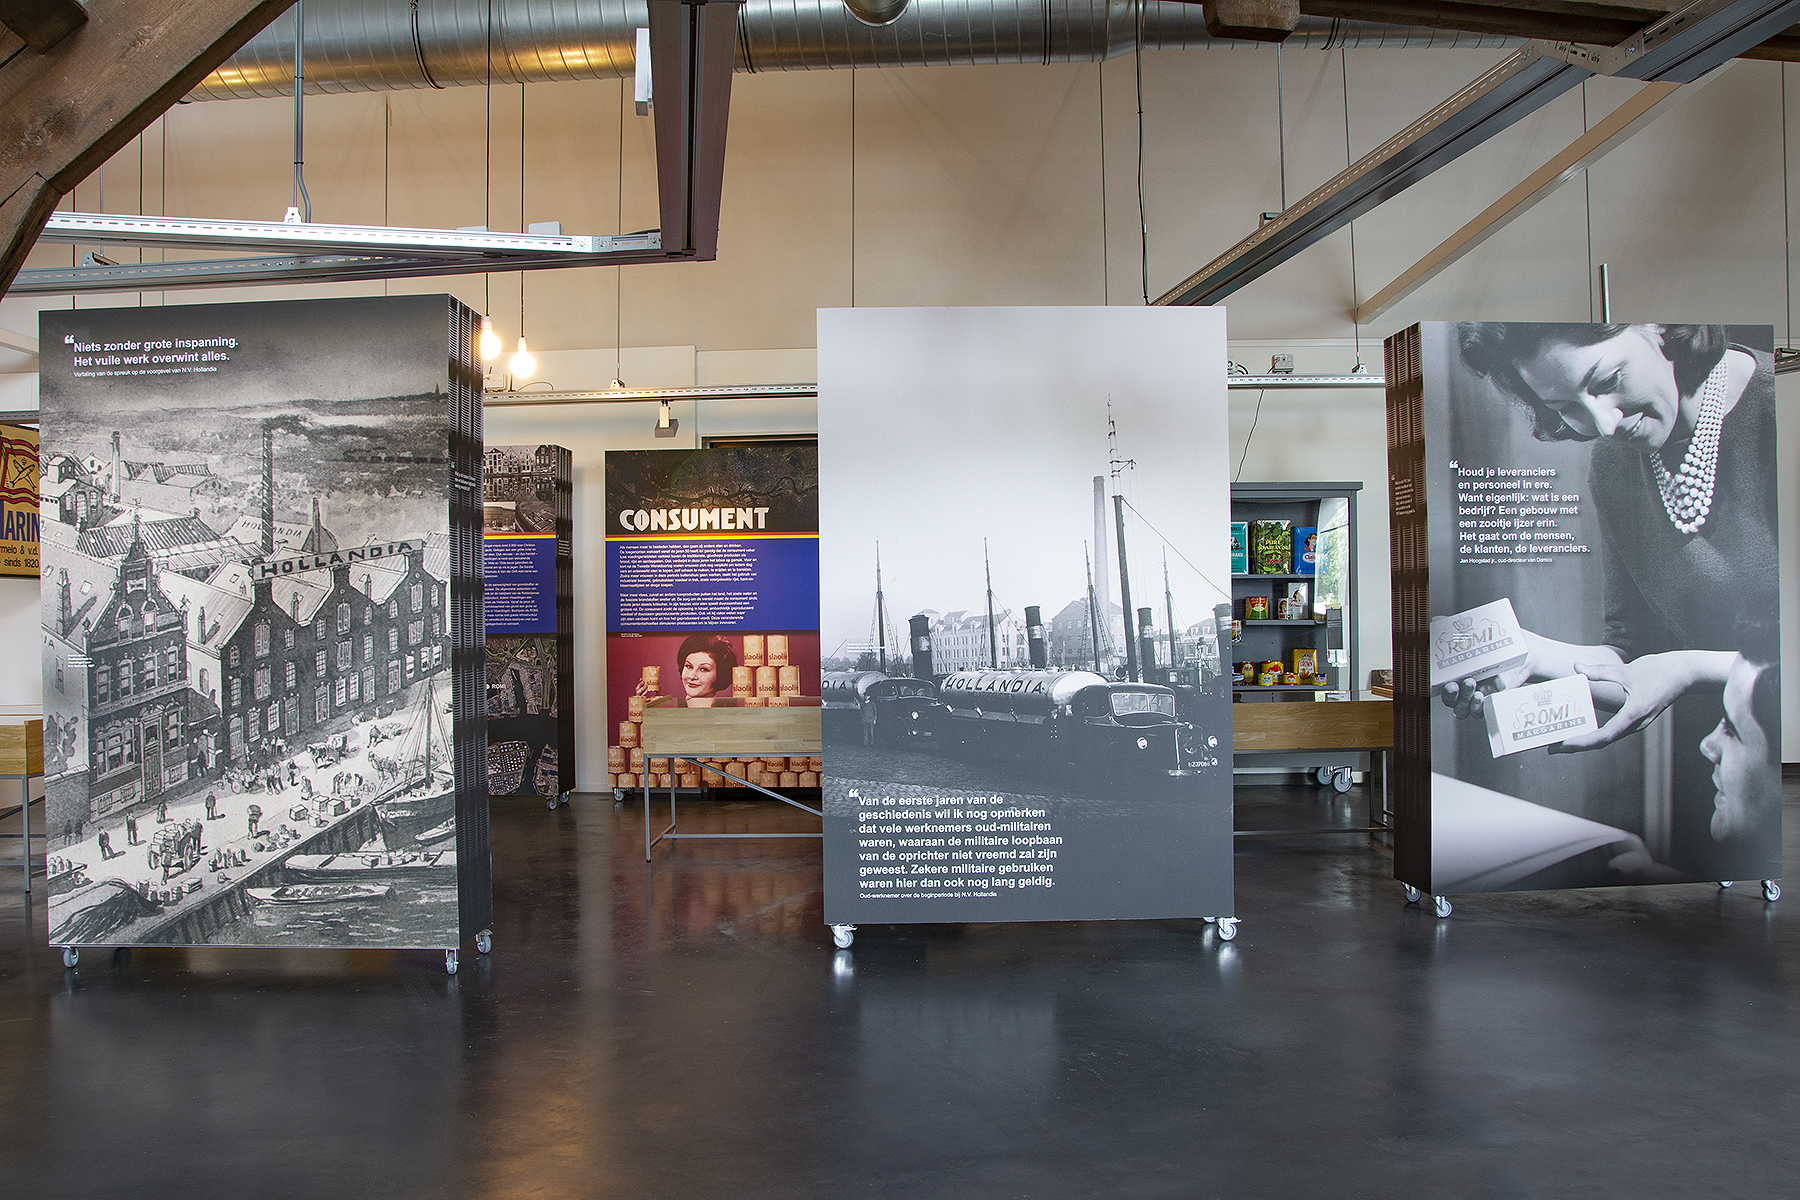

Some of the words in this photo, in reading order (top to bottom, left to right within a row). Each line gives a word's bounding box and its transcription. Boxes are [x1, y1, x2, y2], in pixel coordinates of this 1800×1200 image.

[73, 342, 102, 352] Niets
[103, 340, 142, 351] zonder
[143, 339, 172, 352] grote
[175, 336, 239, 349] inspanning.
[74, 356, 93, 367] Het
[94, 355, 121, 366] vuile
[123, 353, 150, 364] werk
[151, 352, 199, 363] overwint
[201, 350, 231, 362] alles.
[1457, 467, 1484, 477] Houd
[1485, 467, 1496, 478] je
[1497, 466, 1556, 477] leveranciers
[1457, 481, 1471, 489] en
[1472, 479, 1521, 491] personeel
[1522, 479, 1532, 489] in
[1533, 481, 1553, 489] ere.
[1458, 492, 1484, 502] Want
[1485, 492, 1529, 504] eigenlijk:
[1530, 492, 1549, 502] wat
[1550, 492, 1560, 502] is
[1561, 494, 1580, 502] een
[1458, 505, 1496, 517] bedrijf?
[1498, 505, 1517, 515] Een
[1519, 505, 1558, 517] gebouw
[1559, 505, 1578, 515] met
[0, 500, 40, 542] ARIN
[619, 507, 770, 532] CONSUMENT
[1458, 520, 1477, 528] een
[1478, 518, 1512, 529] zooitje
[1513, 518, 1535, 530] ijzer
[1536, 517, 1559, 528] erin.
[1459, 531, 1477, 541] Het
[1478, 531, 1500, 543] gaat
[1501, 532, 1518, 541] om
[1519, 530, 1532, 540] de
[1534, 532, 1575, 542] mensen,
[1459, 544, 1472, 554] de
[1474, 544, 1513, 556] klanten,
[1514, 543, 1528, 553] de
[1529, 543, 1591, 553] leveranciers.
[4, 557, 22, 567] sinds
[24, 558, 40, 568] 1820
[261, 542, 413, 578] HOLLANDIA
[1441, 639, 1511, 668] MARGARINE
[944, 677, 1043, 694] HOLLANDIA
[1524, 703, 1569, 729] ROMI
[1516, 718, 1584, 740] MARGARINE
[858, 795, 880, 806] Van
[881, 794, 896, 806] de
[898, 794, 934, 806] eerste
[933, 794, 964, 807] jaren
[966, 794, 987, 805] van
[989, 794, 1004, 804] de
[858, 809, 932, 822] geschiedenis
[934, 808, 951, 819] wil
[953, 808, 964, 819] ik
[966, 810, 988, 821] nog
[990, 806, 1046, 820] opmerken
[858, 823, 877, 834] dat
[878, 823, 902, 833] vele
[904, 823, 972, 833] werknemers
[975, 821, 1051, 832] oud-militairen
[858, 839, 896, 849] waren,
[898, 838, 945, 847] waaraan
[947, 836, 962, 846] de
[964, 835, 1009, 846] militaire
[1011, 835, 1063, 847] loopbaan
[858, 852, 880, 861] van
[881, 850, 896, 861] de
[898, 850, 949, 862] oprichter
[951, 849, 973, 860] niet
[975, 848, 1017, 859] vreemd
[1018, 848, 1035, 859] zal
[1037, 848, 1057, 861] zijn
[859, 864, 909, 877] geweest.
[910, 864, 949, 874] Zekere
[951, 863, 996, 874] militaire
[998, 862, 1054, 875] gebruiken
[859, 880, 893, 888] waren
[895, 877, 918, 888] hier
[919, 877, 941, 888] dan
[943, 877, 965, 887] ook
[967, 878, 989, 889] nog
[991, 876, 1016, 889] lang
[1018, 875, 1056, 888] geldig.
